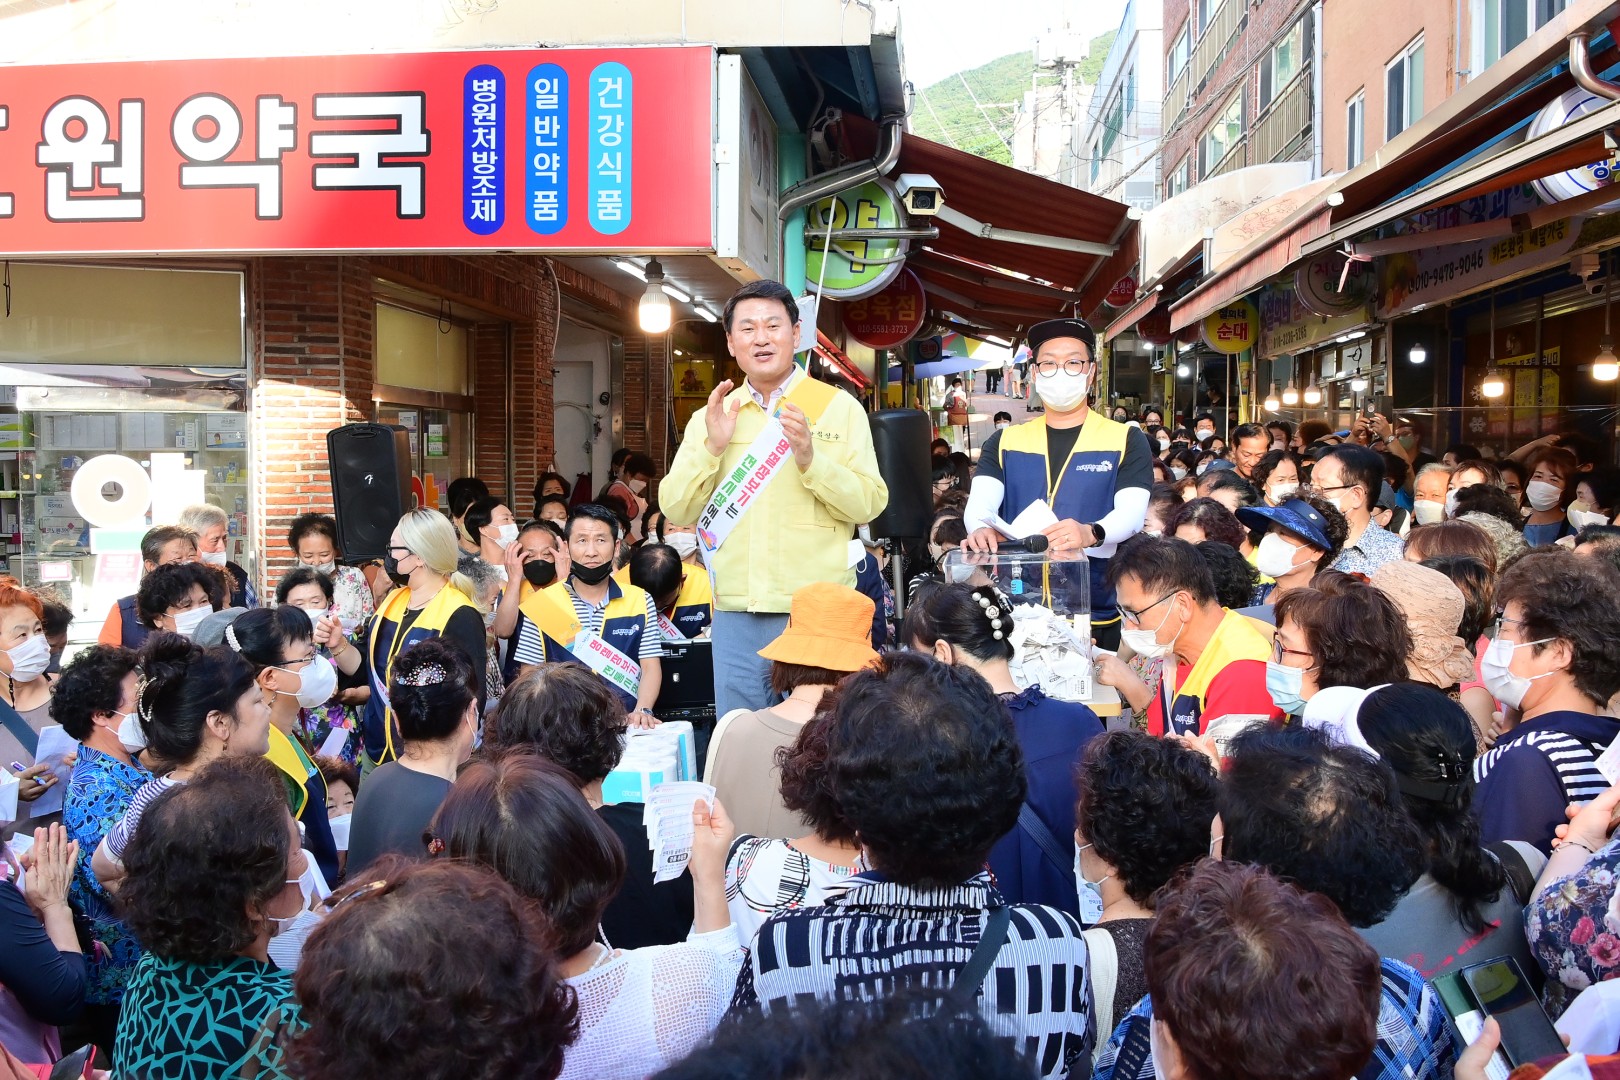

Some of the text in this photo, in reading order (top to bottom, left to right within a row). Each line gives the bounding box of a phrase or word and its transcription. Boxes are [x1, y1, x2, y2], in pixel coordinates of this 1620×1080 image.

[0, 92, 431, 222] 원약국
[471, 78, 497, 223] 병원처방조제
[533, 77, 560, 222] 일반약품
[596, 76, 624, 222] 건강식품
[1415, 249, 1484, 291] 010-9478-9046
[1492, 217, 1565, 262] 카드환영 배달가능
[857, 324, 908, 334] 010-5581-3723
[1216, 322, 1248, 341] 순대
[700, 453, 758, 530] 전통시장에서
